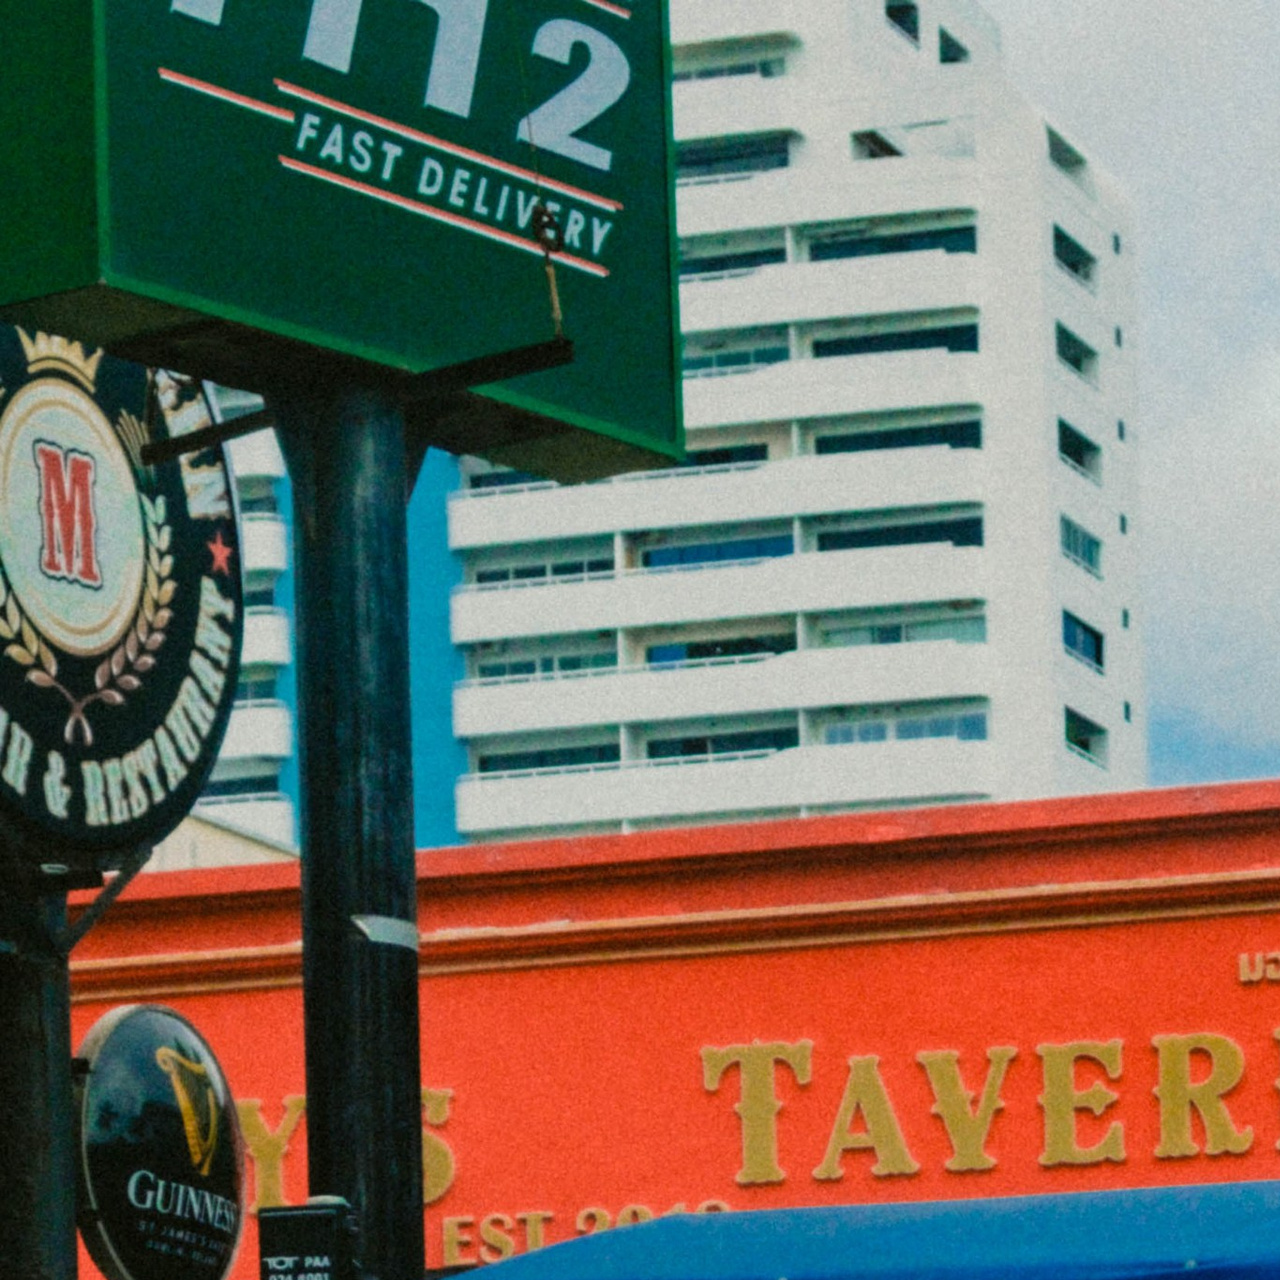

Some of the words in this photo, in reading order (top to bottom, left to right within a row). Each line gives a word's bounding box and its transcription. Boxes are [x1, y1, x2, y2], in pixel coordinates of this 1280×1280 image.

[296, 112, 402, 181] FAST
[417, 158, 613, 255] DELIVERY
[33, 440, 102, 590] M
[81, 576, 234, 826] RESTAURANT
[127, 1169, 238, 1233] GUINNESS
[442, 1210, 553, 1266] EST
